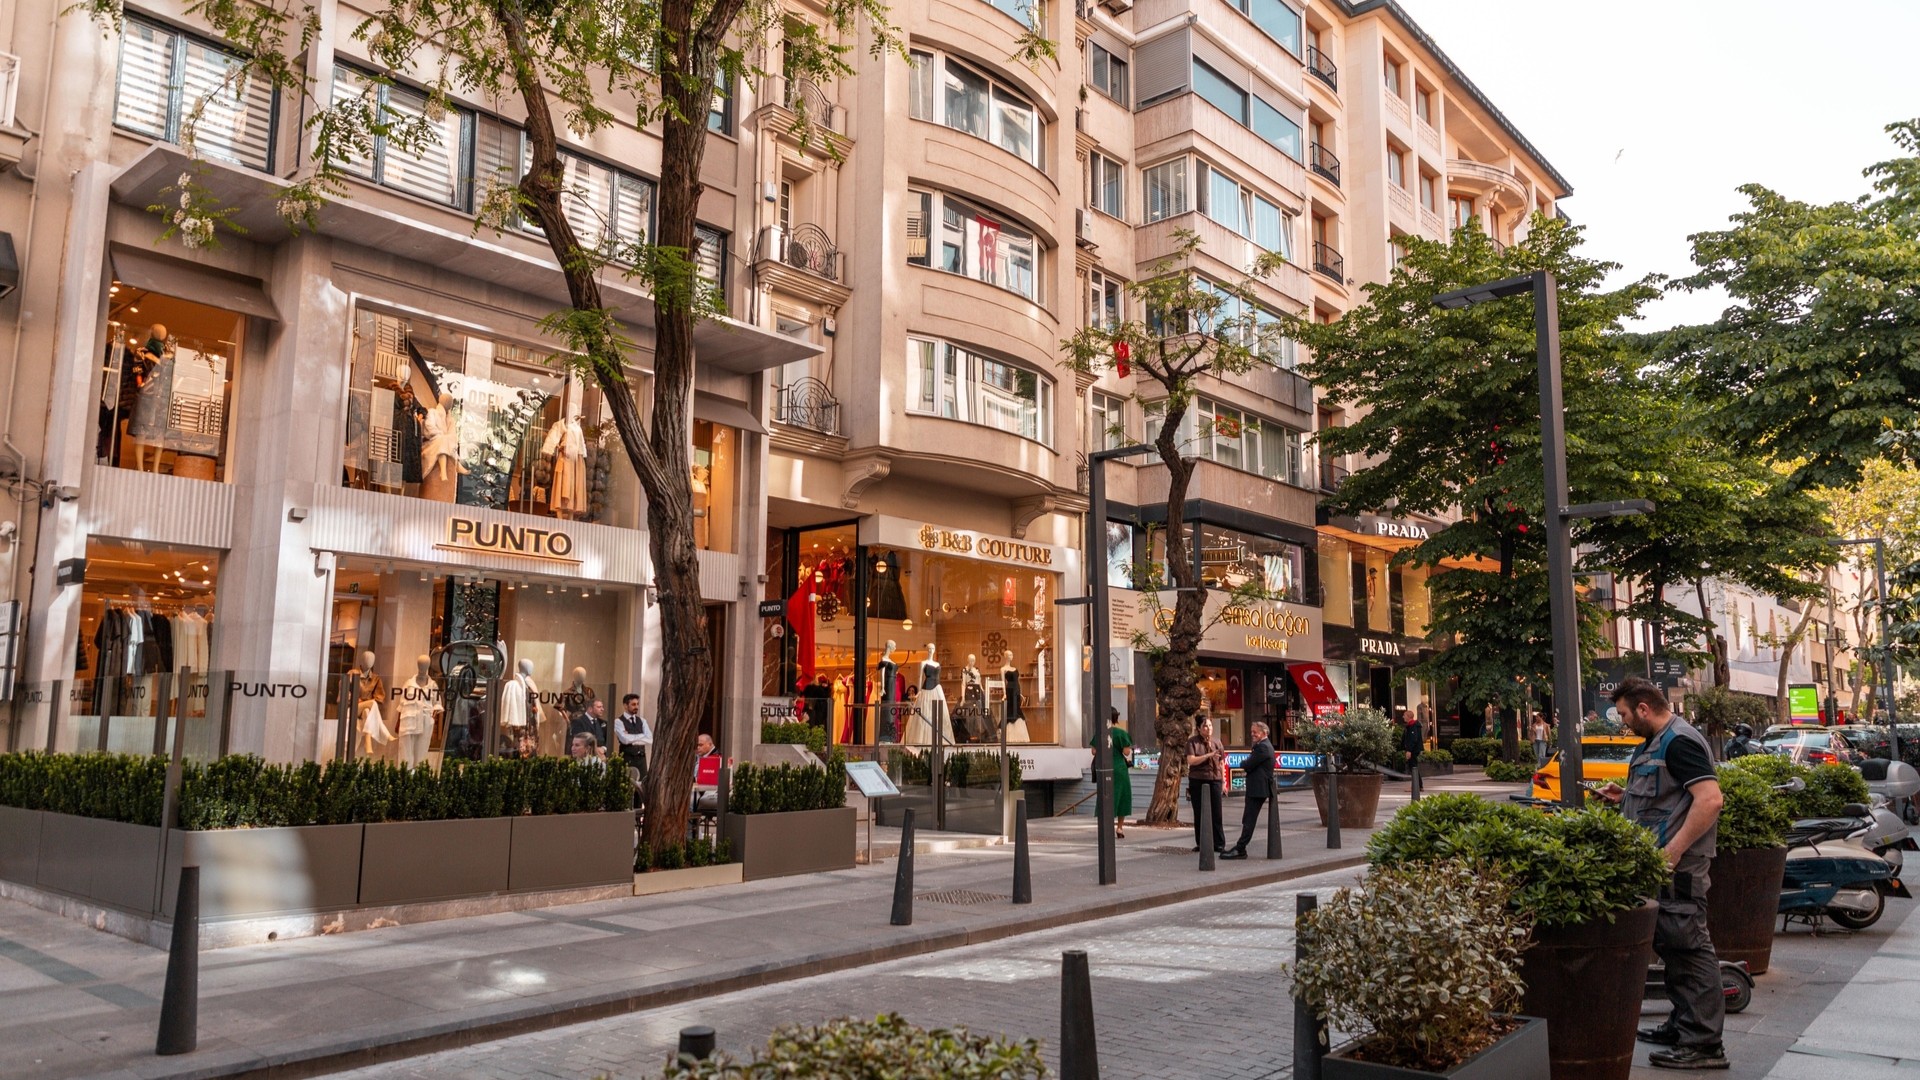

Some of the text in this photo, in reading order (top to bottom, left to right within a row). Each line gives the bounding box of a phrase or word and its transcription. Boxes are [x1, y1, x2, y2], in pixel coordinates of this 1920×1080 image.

[451, 518, 572, 556] PUNTO
[1377, 522, 1429, 540] PRADA
[940, 530, 1052, 565] B&B COUTURE
[761, 604, 780, 612] PUNTO
[1265, 607, 1310, 637] doğan
[1360, 637, 1400, 656] PRADA
[187, 684, 210, 698] UNTO
[229, 681, 307, 699] PUNTO
[528, 692, 586, 706] PUNTO
